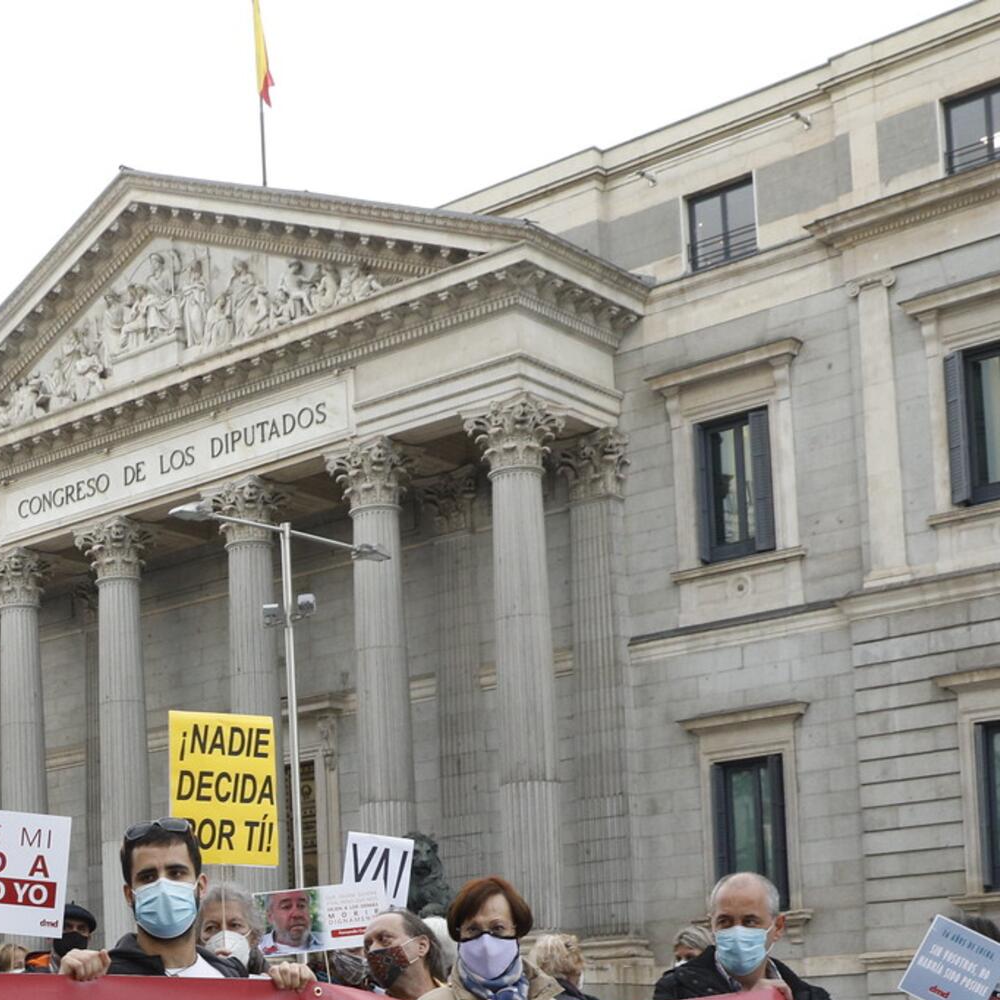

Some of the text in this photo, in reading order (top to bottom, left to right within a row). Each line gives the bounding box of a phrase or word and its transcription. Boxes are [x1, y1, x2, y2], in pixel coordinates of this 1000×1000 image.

[17, 401, 328, 519] CONGRESO DE LOS DIPUTADOS
[178, 723, 271, 762] ¡NADIE
[176, 770, 275, 806] DECIDA
[20, 826, 53, 849] MI
[244, 814, 274, 853] TÍ!
[13, 882, 49, 906] YO
[39, 918, 59, 929] dmd
